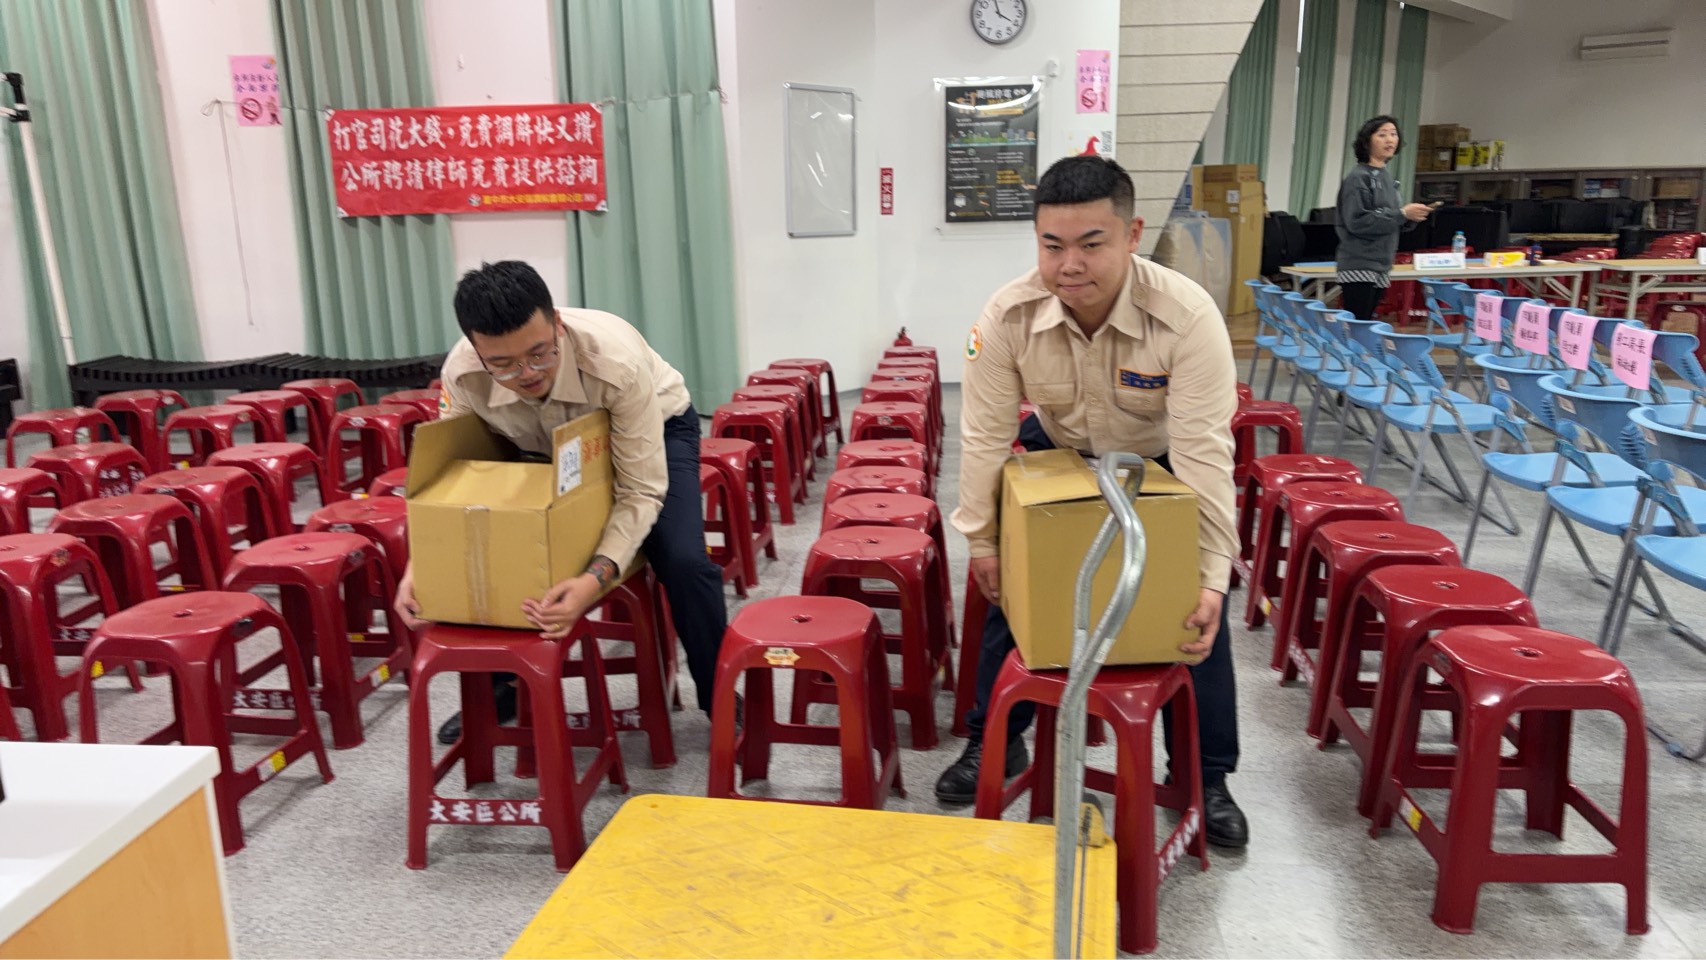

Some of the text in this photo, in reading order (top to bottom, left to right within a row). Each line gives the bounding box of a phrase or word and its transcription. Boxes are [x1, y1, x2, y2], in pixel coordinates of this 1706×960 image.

[341, 155, 599, 192] 公所聘請律師免費提供諮詢
[429, 799, 542, 823] 大安區公所
